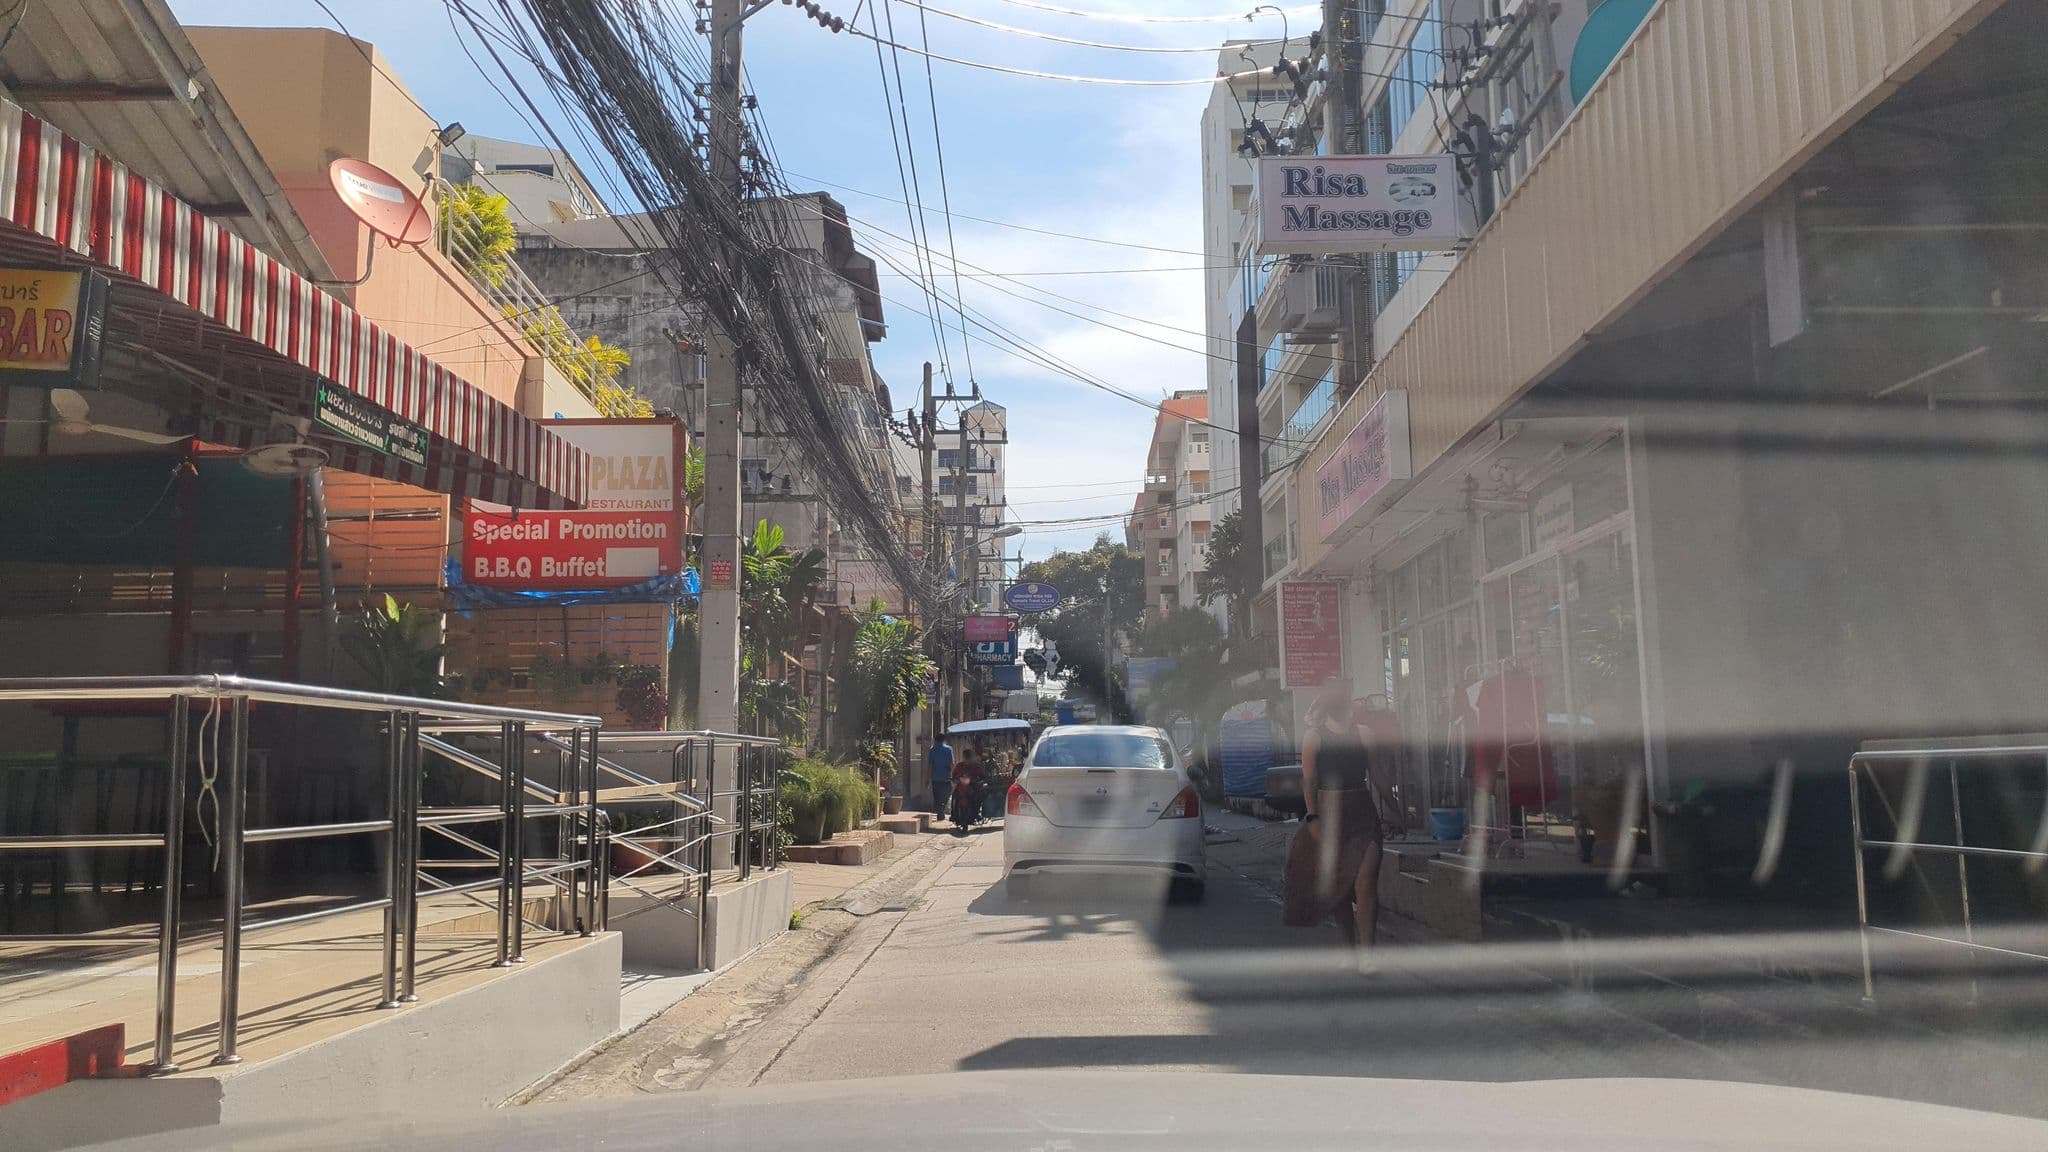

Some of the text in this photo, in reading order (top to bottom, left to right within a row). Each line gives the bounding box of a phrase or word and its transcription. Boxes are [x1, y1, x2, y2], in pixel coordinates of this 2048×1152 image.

[1281, 166, 1368, 198] Risa
[1282, 205, 1432, 237] Massage
[0, 306, 72, 361] BAR
[592, 455, 670, 491] PLAZA
[1343, 432, 1385, 499] Massage
[473, 519, 667, 544] Special Promotion
[475, 556, 606, 578] B.B.Q Buffet
